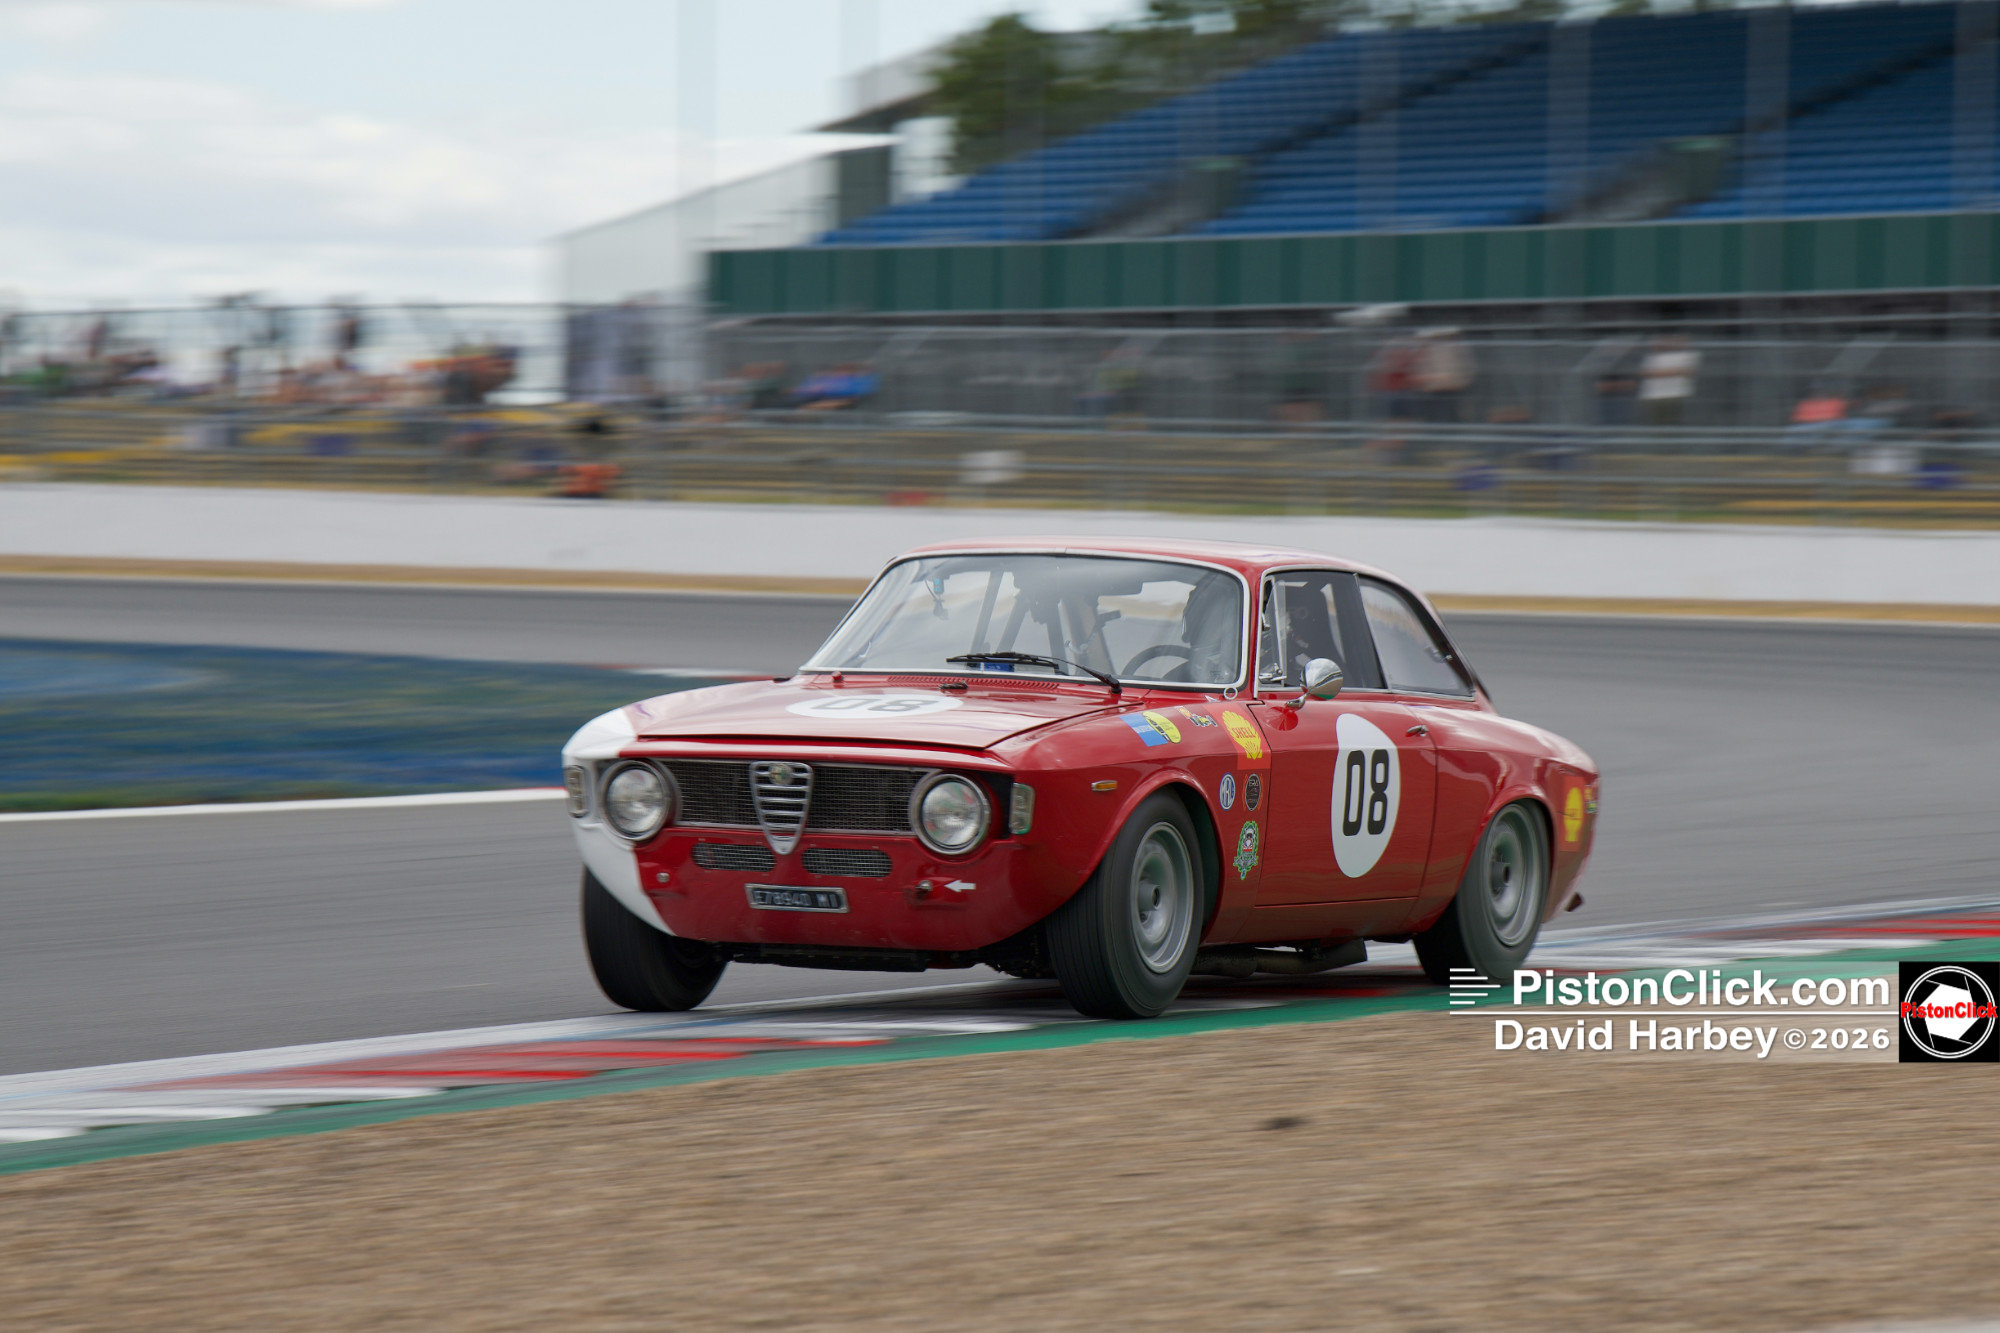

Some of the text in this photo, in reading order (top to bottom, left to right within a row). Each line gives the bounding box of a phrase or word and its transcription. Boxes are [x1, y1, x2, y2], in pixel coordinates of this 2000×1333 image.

[811, 699, 939, 712] 08
[1231, 726, 1256, 740] SHELL
[1342, 748, 1390, 837] 08
